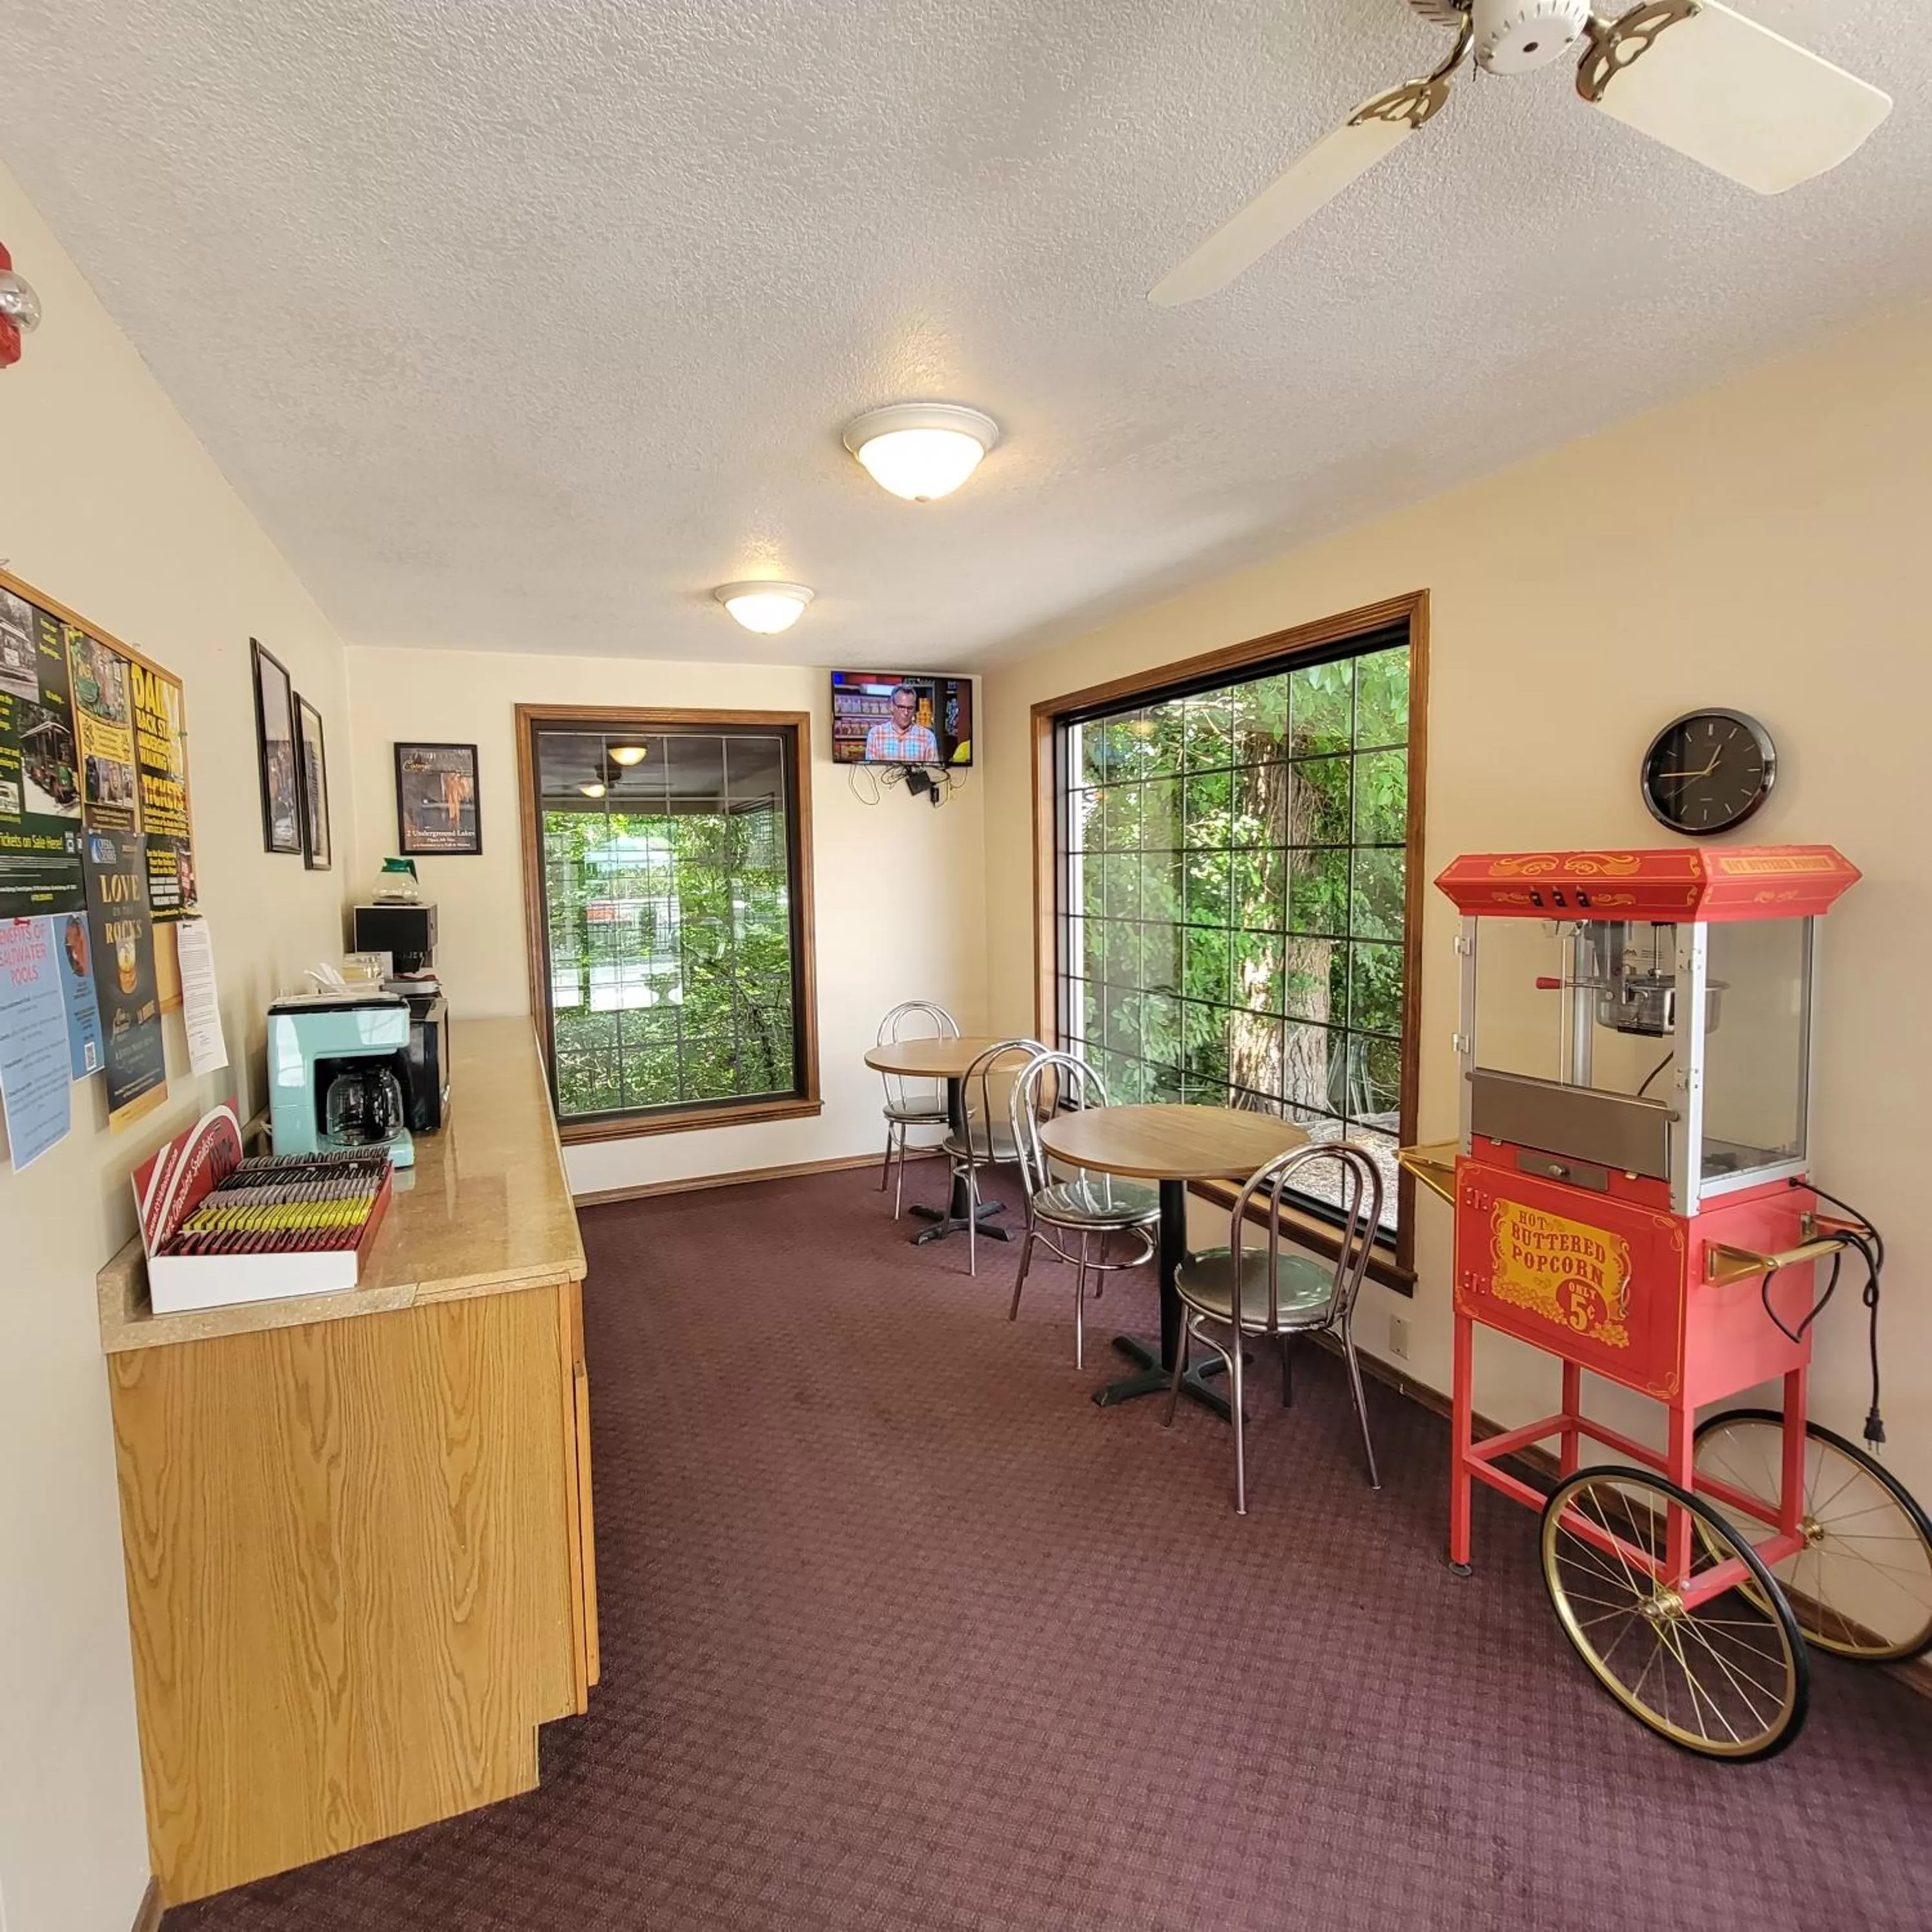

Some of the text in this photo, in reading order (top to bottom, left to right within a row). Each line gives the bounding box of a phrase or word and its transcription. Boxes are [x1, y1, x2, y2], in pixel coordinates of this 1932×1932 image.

[141, 774, 185, 810] TICKETS
[0, 831, 22, 848] ickets
[23, 837, 32, 848] on
[32, 834, 46, 848] Sale
[0, 923, 46, 945] ENEFITS OF
[105, 919, 142, 944] ROCKS
[10, 967, 39, 985] POOLS
[1518, 1209, 1547, 1230] HOT
[1511, 1220, 1607, 1264] BUTTERED
[1511, 1244, 1605, 1290] POPCORN
[1568, 1282, 1596, 1301] ONLY
